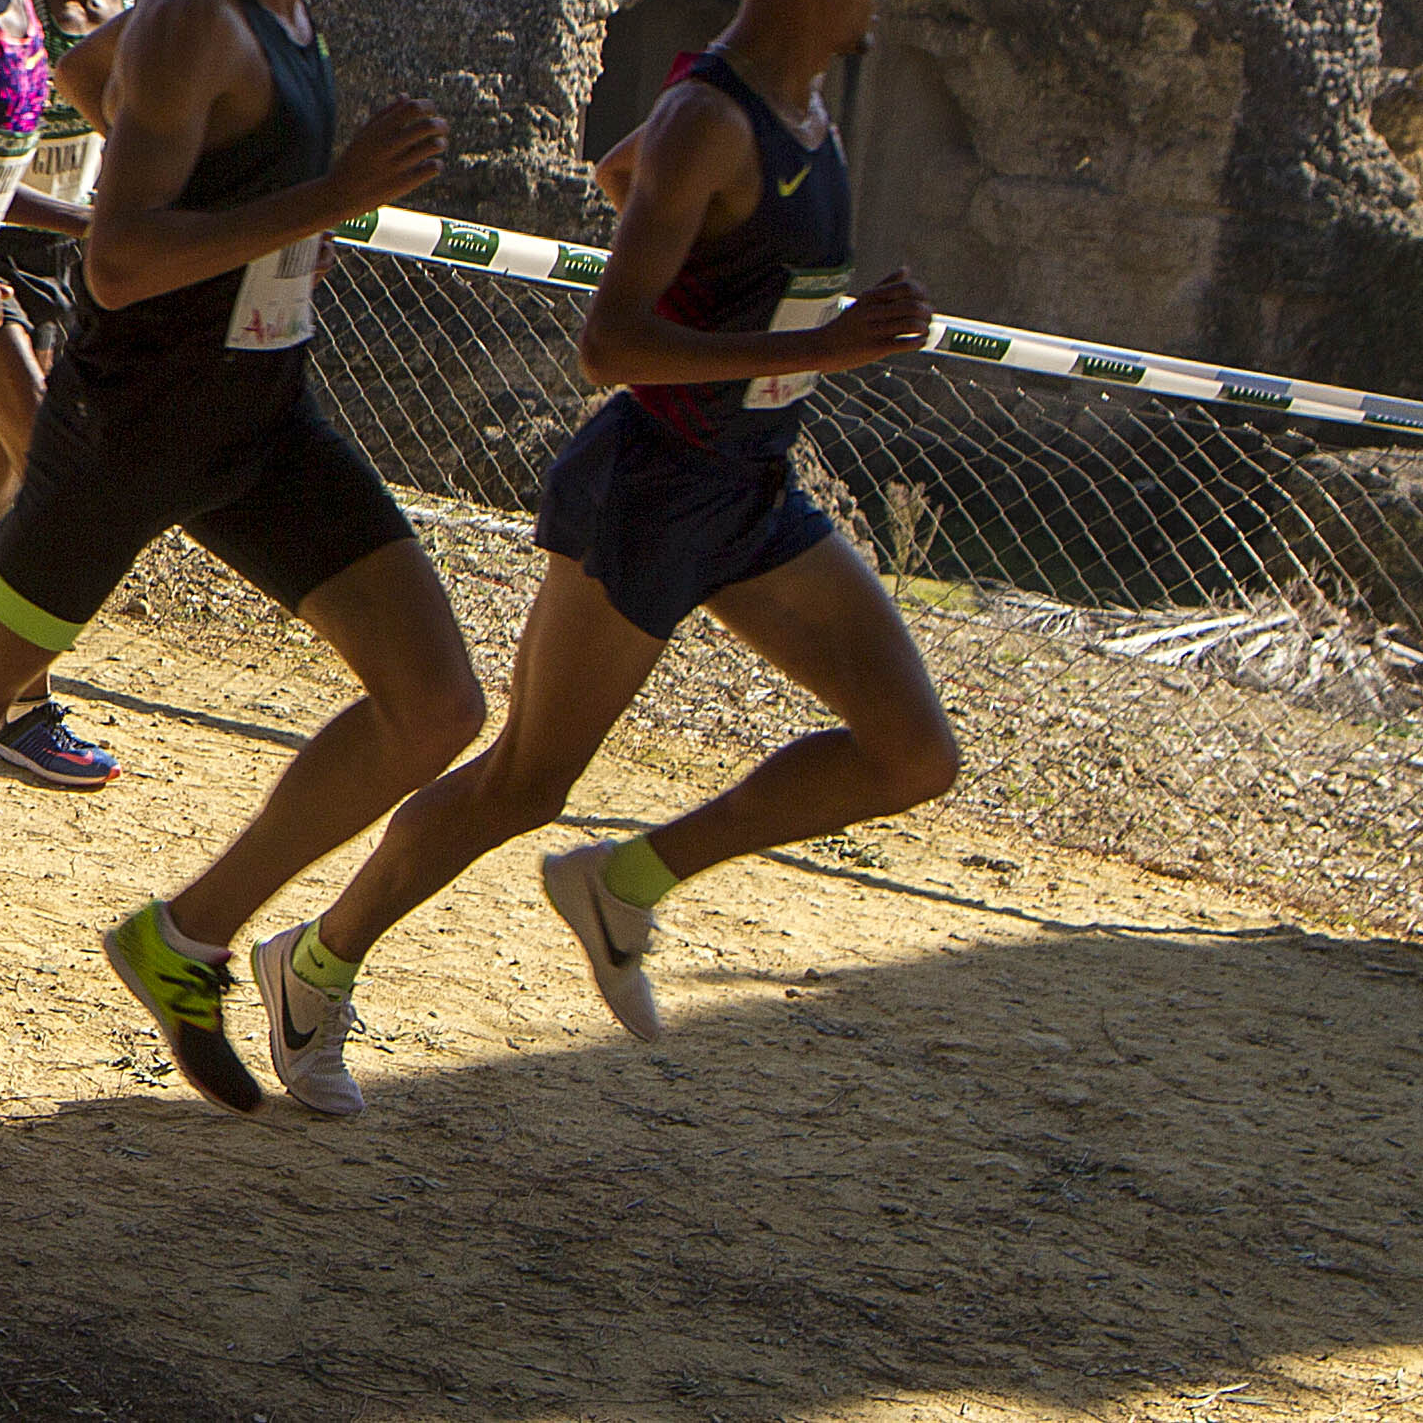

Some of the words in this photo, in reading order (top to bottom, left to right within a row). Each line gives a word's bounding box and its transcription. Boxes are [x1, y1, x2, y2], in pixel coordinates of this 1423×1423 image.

[447, 237, 487, 254] SEVILLA
[953, 332, 998, 349] SEVILLA
[1086, 356, 1134, 373] SEVILLA
